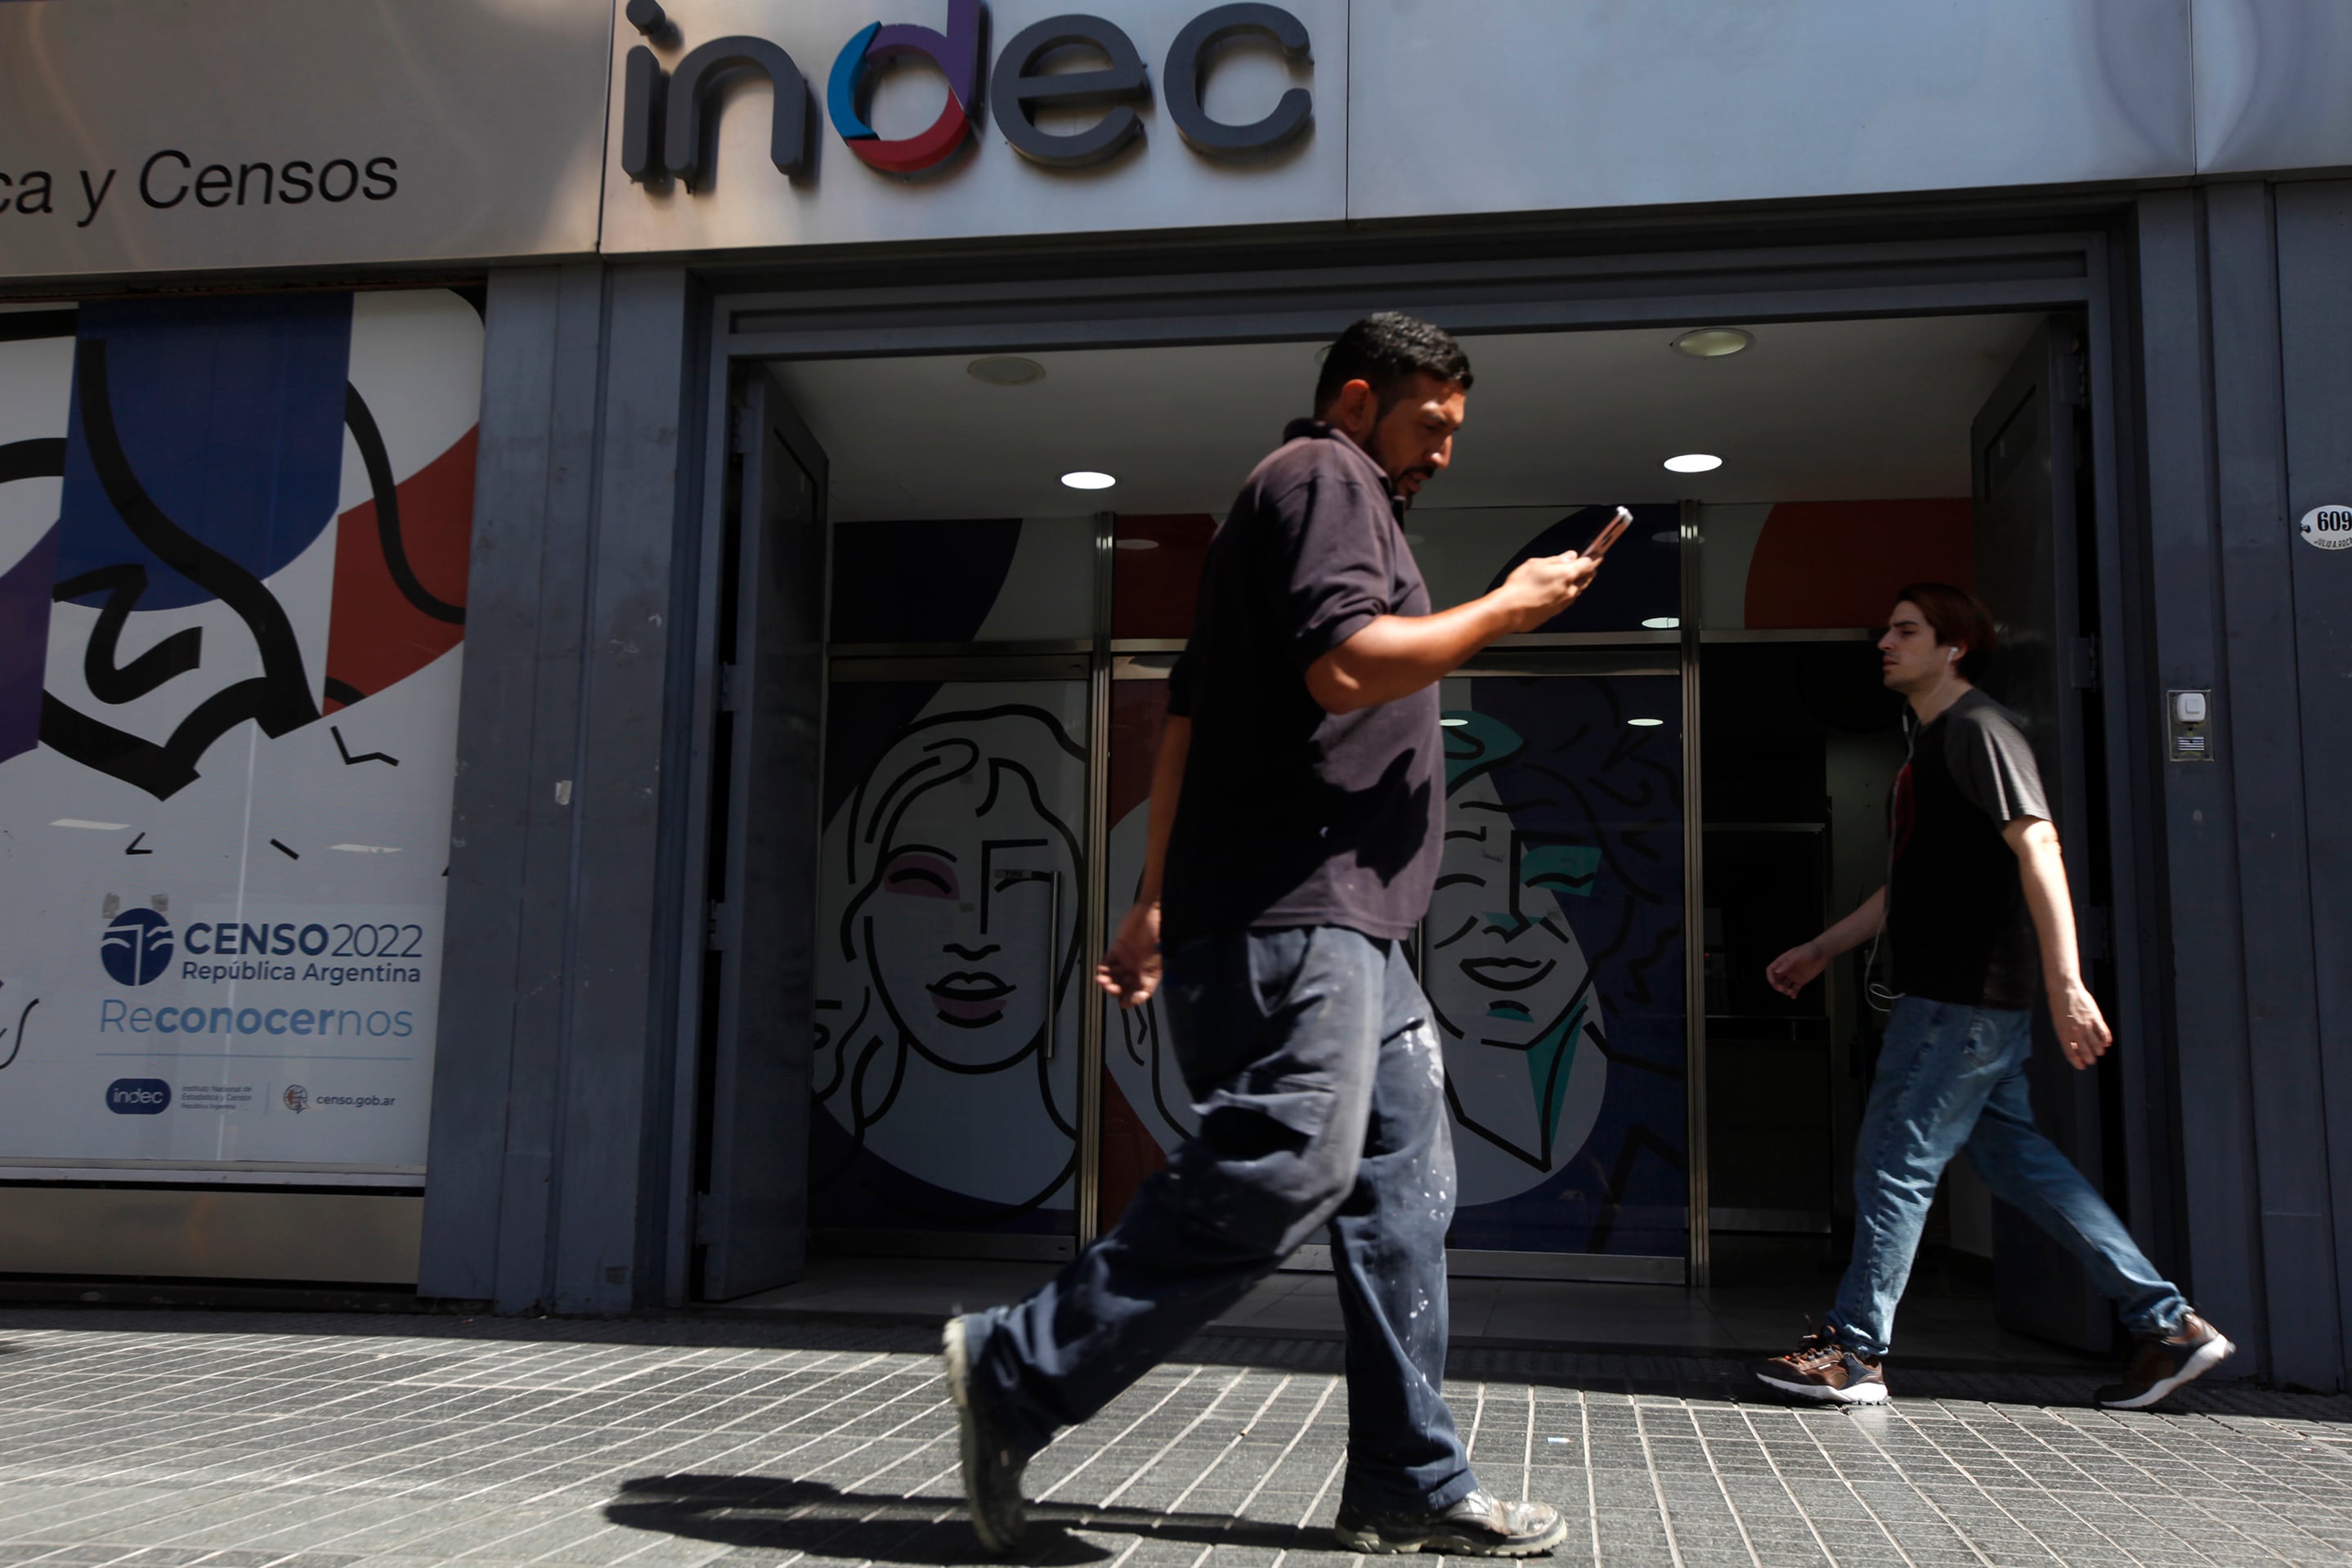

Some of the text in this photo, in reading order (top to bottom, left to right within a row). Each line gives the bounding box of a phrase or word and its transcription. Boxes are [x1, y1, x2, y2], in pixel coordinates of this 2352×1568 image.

[622, 0, 1313, 178] indec
[77, 168, 116, 228] y
[139, 149, 398, 209] Censos
[2317, 511, 2352, 531] 609
[181, 961, 421, 986] República Argentina
[100, 999, 414, 1037] Reconocernos
[113, 1087, 164, 1104] indec
[316, 1094, 396, 1108] censo.gob.ar
